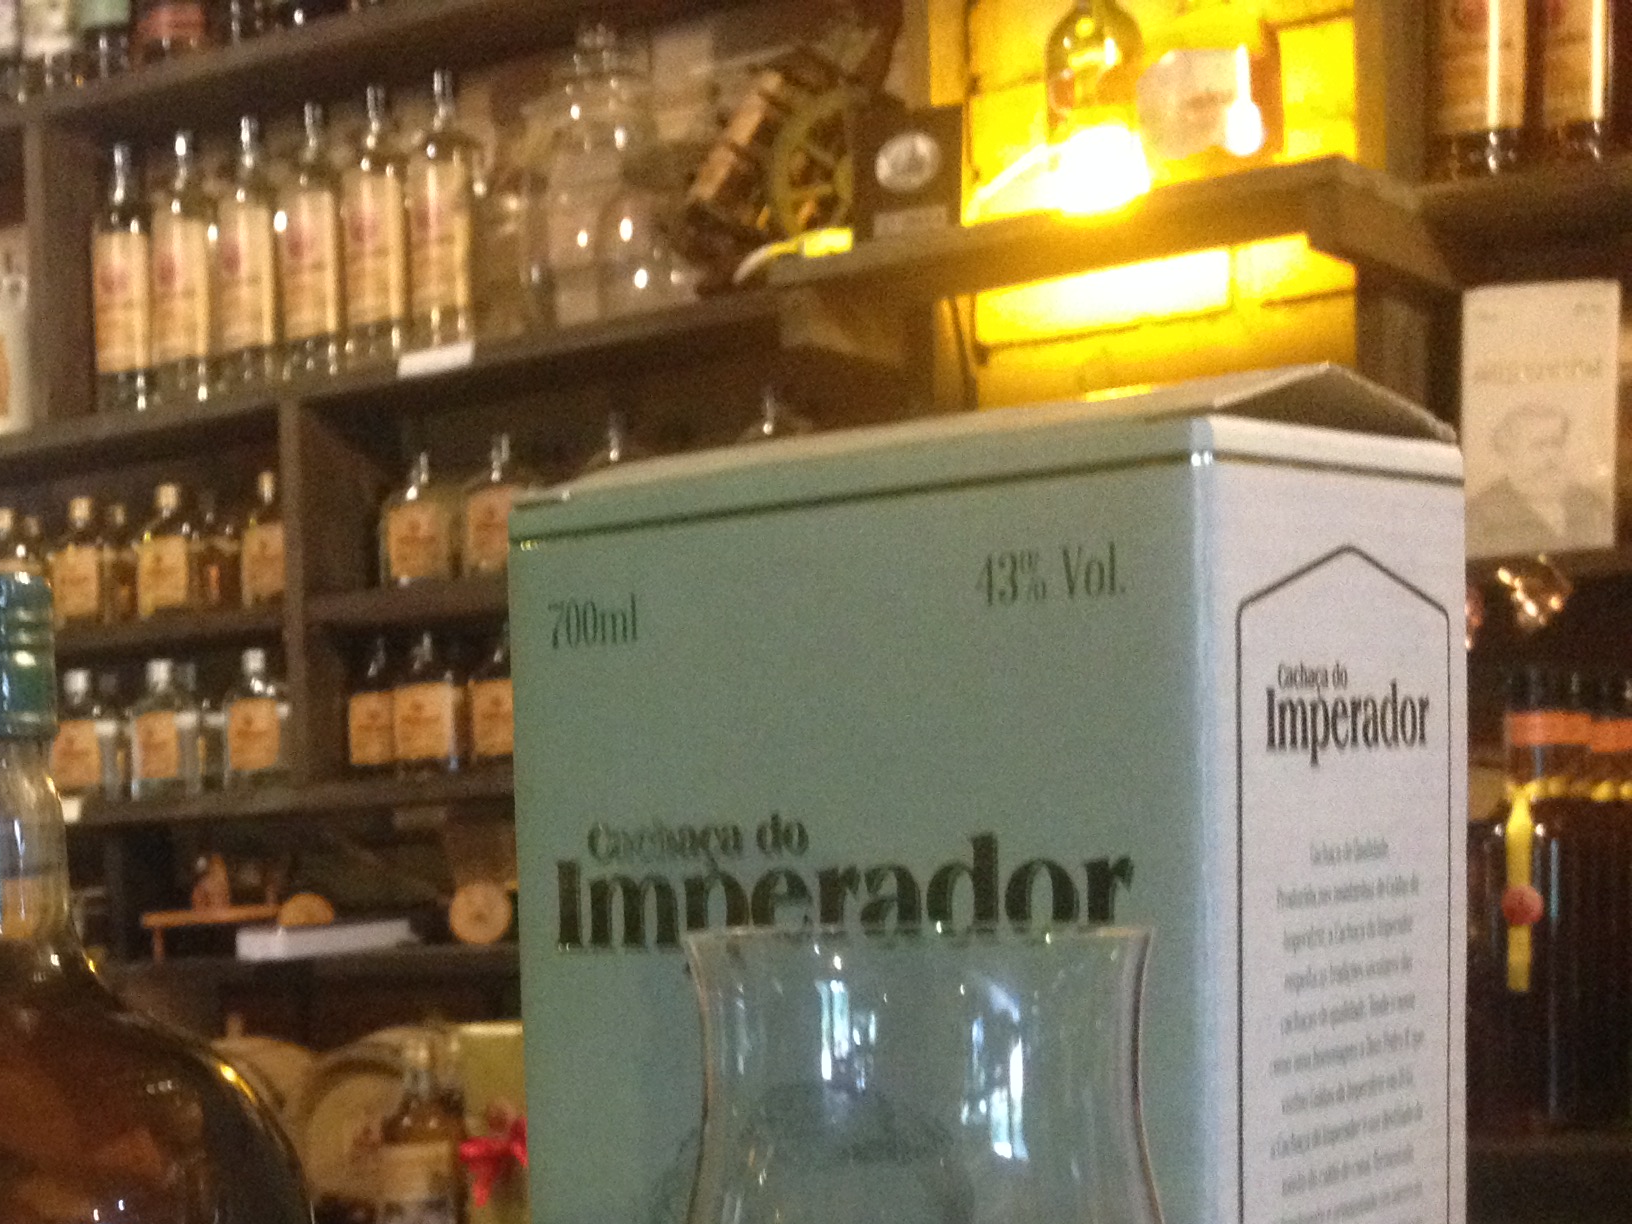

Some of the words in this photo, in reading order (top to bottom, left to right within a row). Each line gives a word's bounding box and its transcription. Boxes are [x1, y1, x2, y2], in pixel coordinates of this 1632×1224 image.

[974, 551, 1048, 607] 43%
[1061, 543, 1127, 601] Vol.
[547, 594, 639, 650] 700ml
[1332, 659, 1349, 691] do
[1266, 677, 1430, 768] Imperador
[756, 812, 810, 857] do
[555, 831, 1136, 958] Imperador
